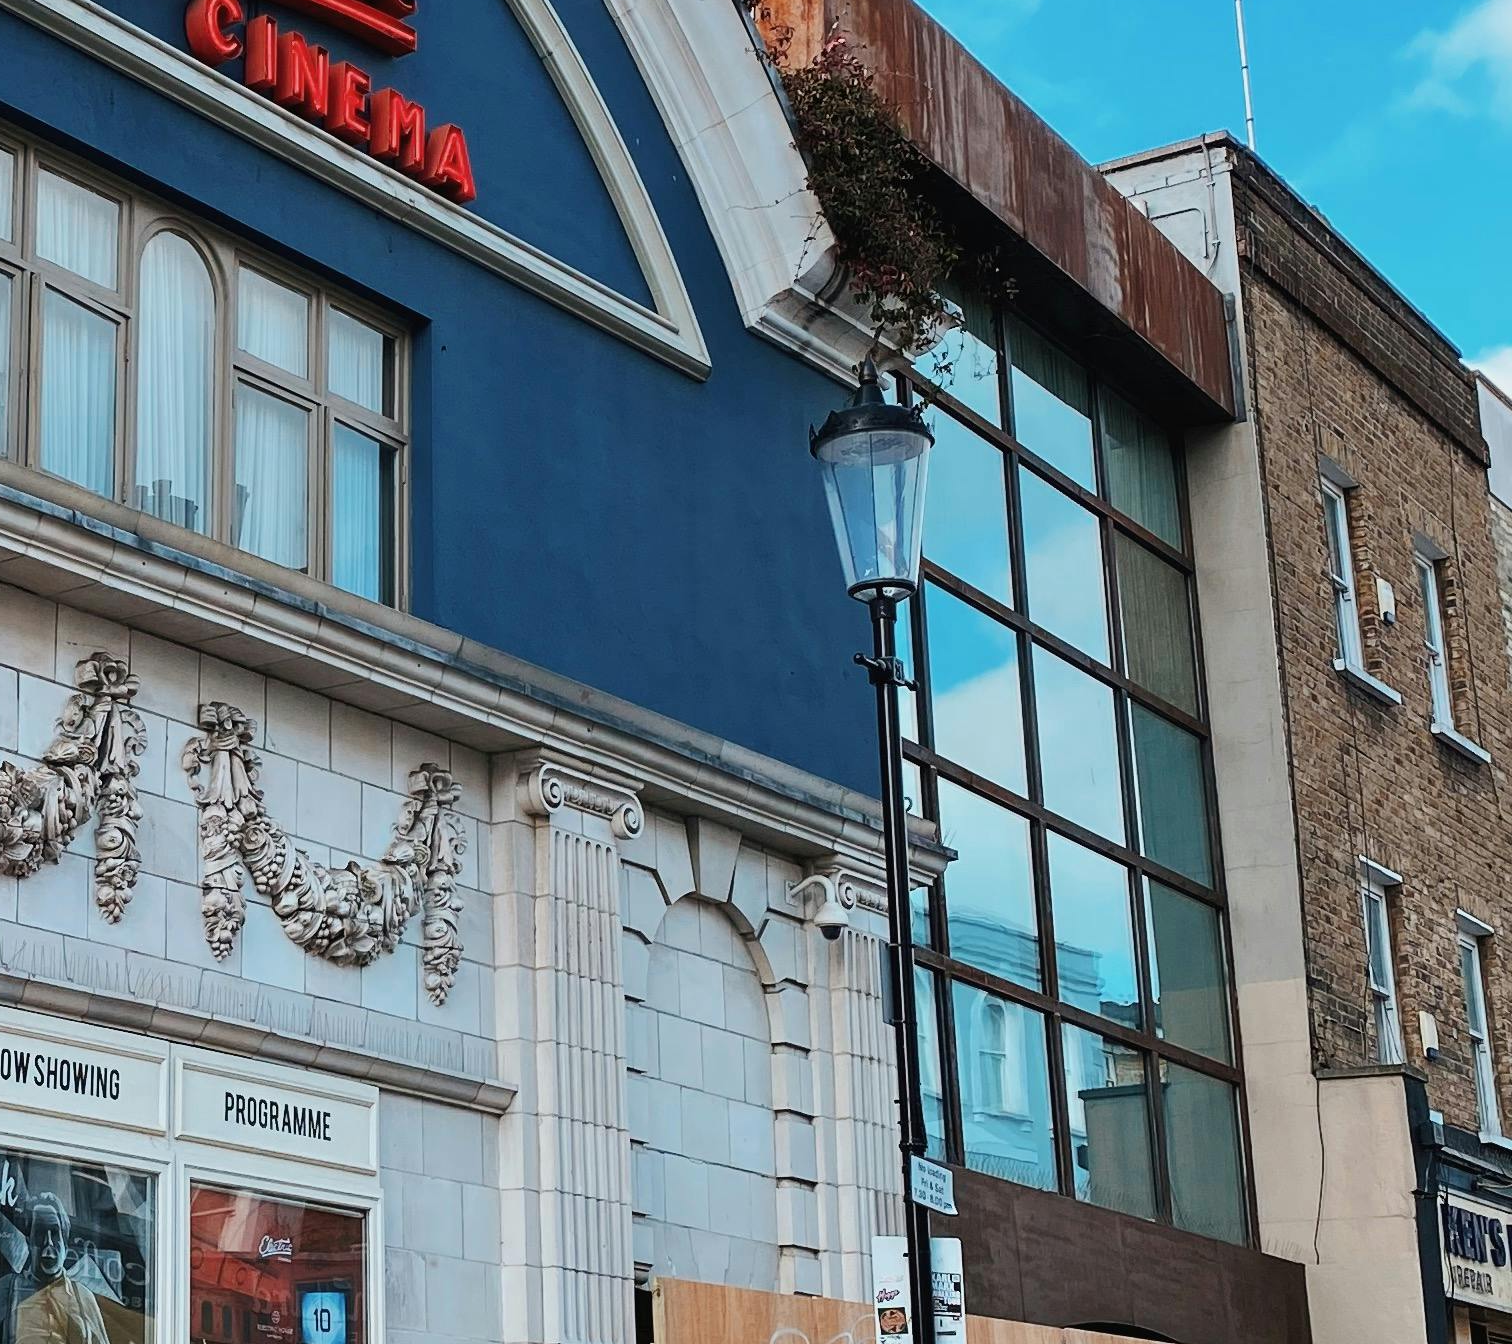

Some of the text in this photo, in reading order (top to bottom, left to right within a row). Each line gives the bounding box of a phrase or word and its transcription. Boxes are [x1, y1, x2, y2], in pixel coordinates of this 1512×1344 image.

[33, 1054, 120, 1101] SHOWING
[224, 1091, 332, 1142] PROGRAMME
[1440, 1203, 1506, 1267] KEN'S
[313, 1307, 331, 1333] 10
